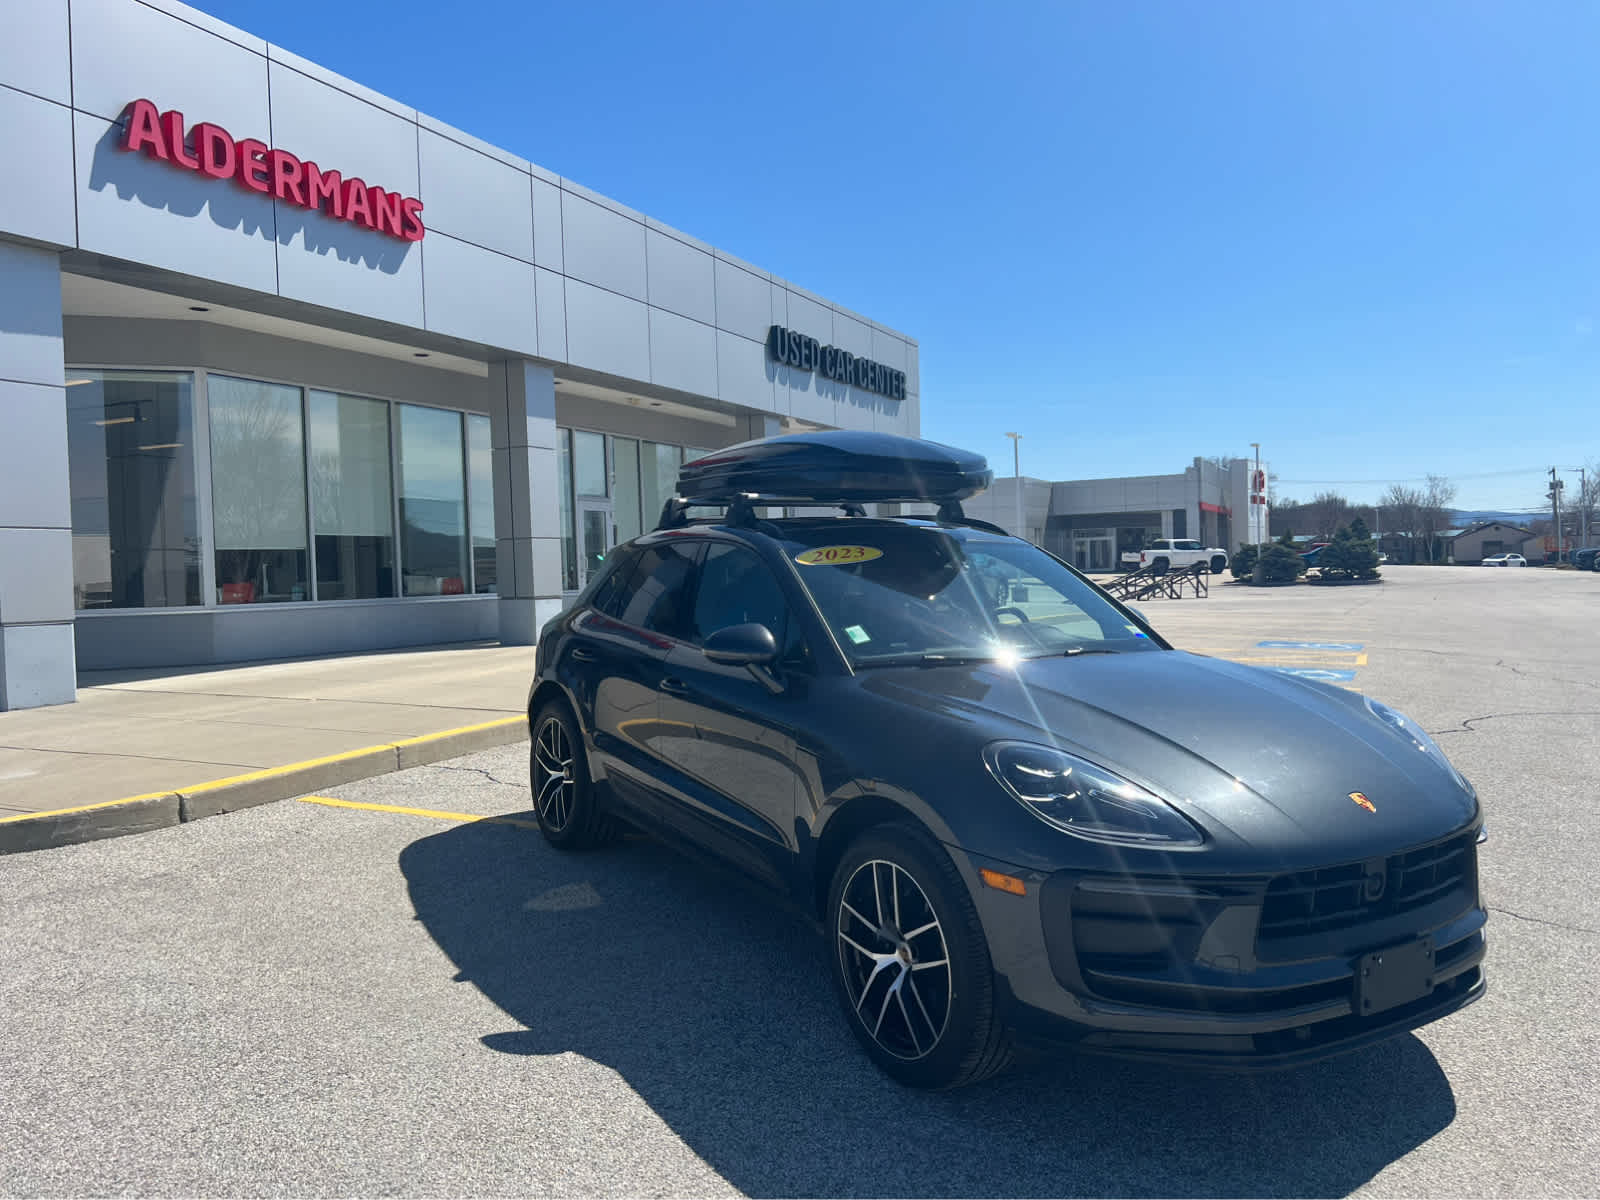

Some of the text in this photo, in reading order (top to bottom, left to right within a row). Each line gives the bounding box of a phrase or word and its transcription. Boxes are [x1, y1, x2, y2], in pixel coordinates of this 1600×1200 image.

[123, 98, 425, 242] ALDERMANS
[770, 325, 907, 400] USED CAR CENTER
[812, 547, 865, 562] 2023
